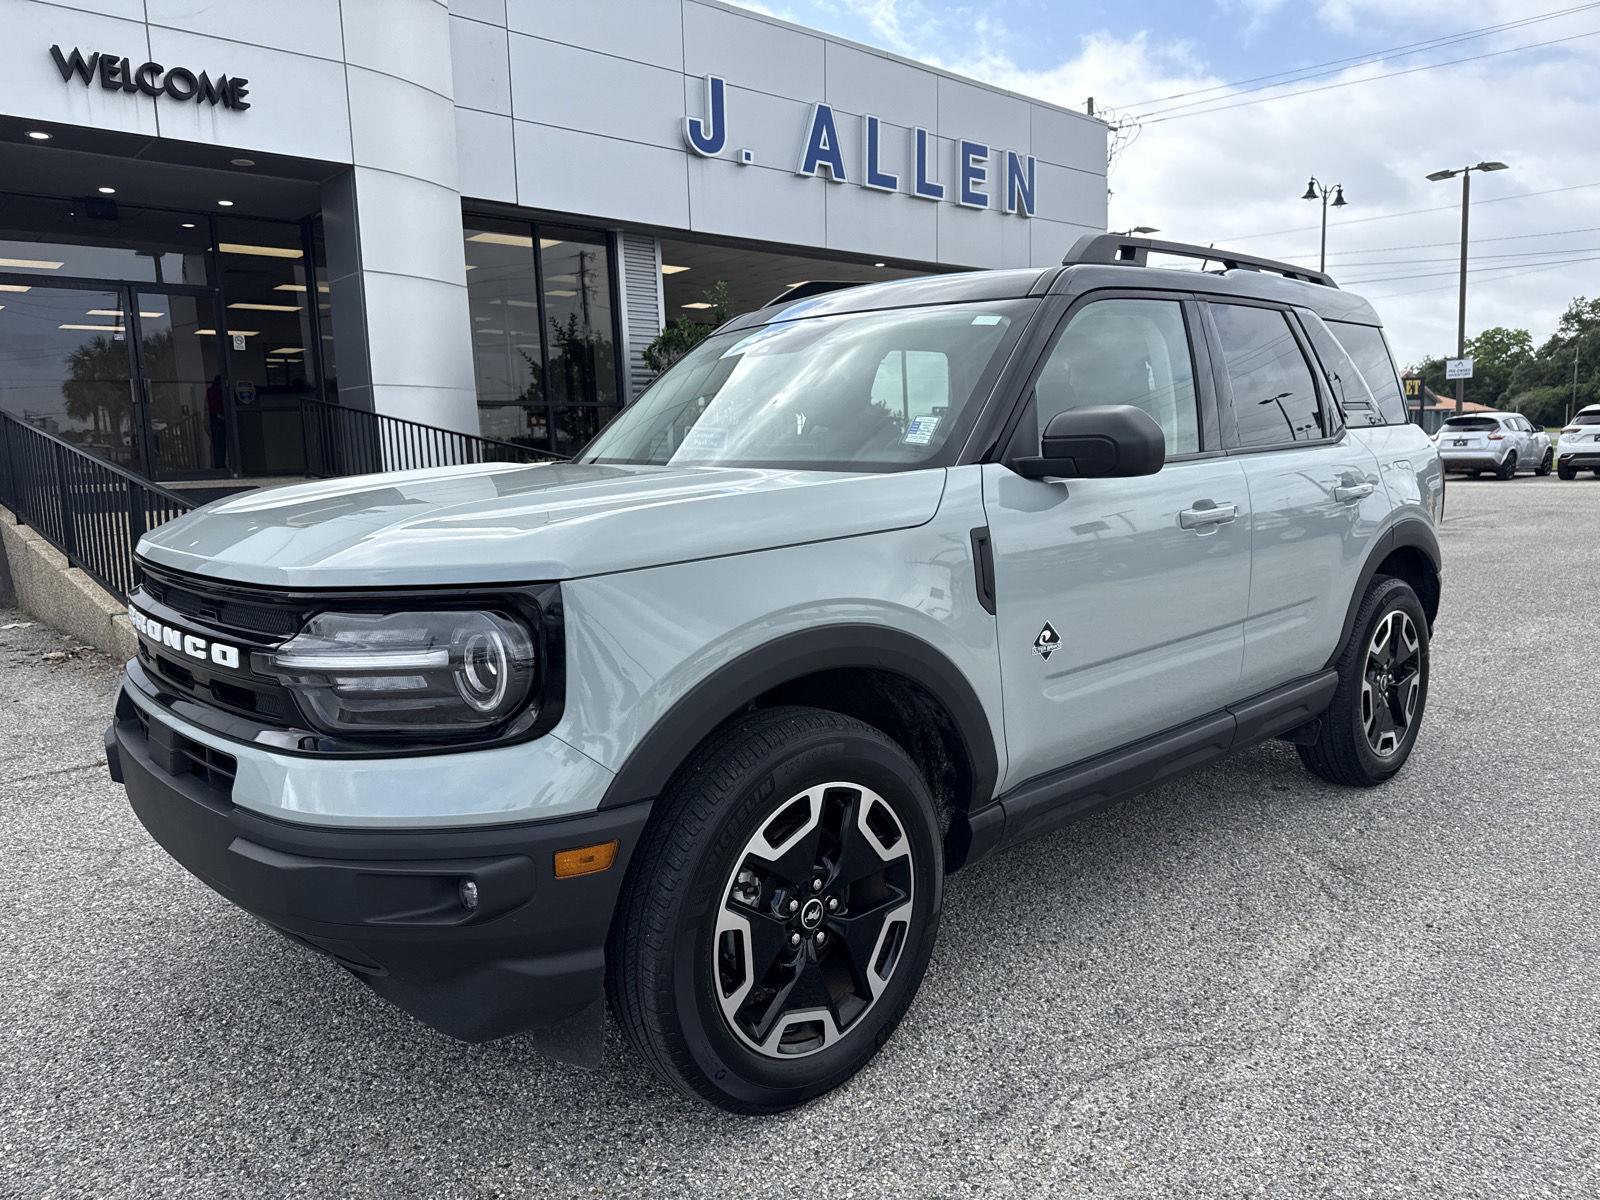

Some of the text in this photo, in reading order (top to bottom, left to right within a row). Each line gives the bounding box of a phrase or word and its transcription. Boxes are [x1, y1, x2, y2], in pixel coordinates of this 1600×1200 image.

[50, 44, 251, 111] WELCOME
[682, 73, 1037, 218] J. ALLEN
